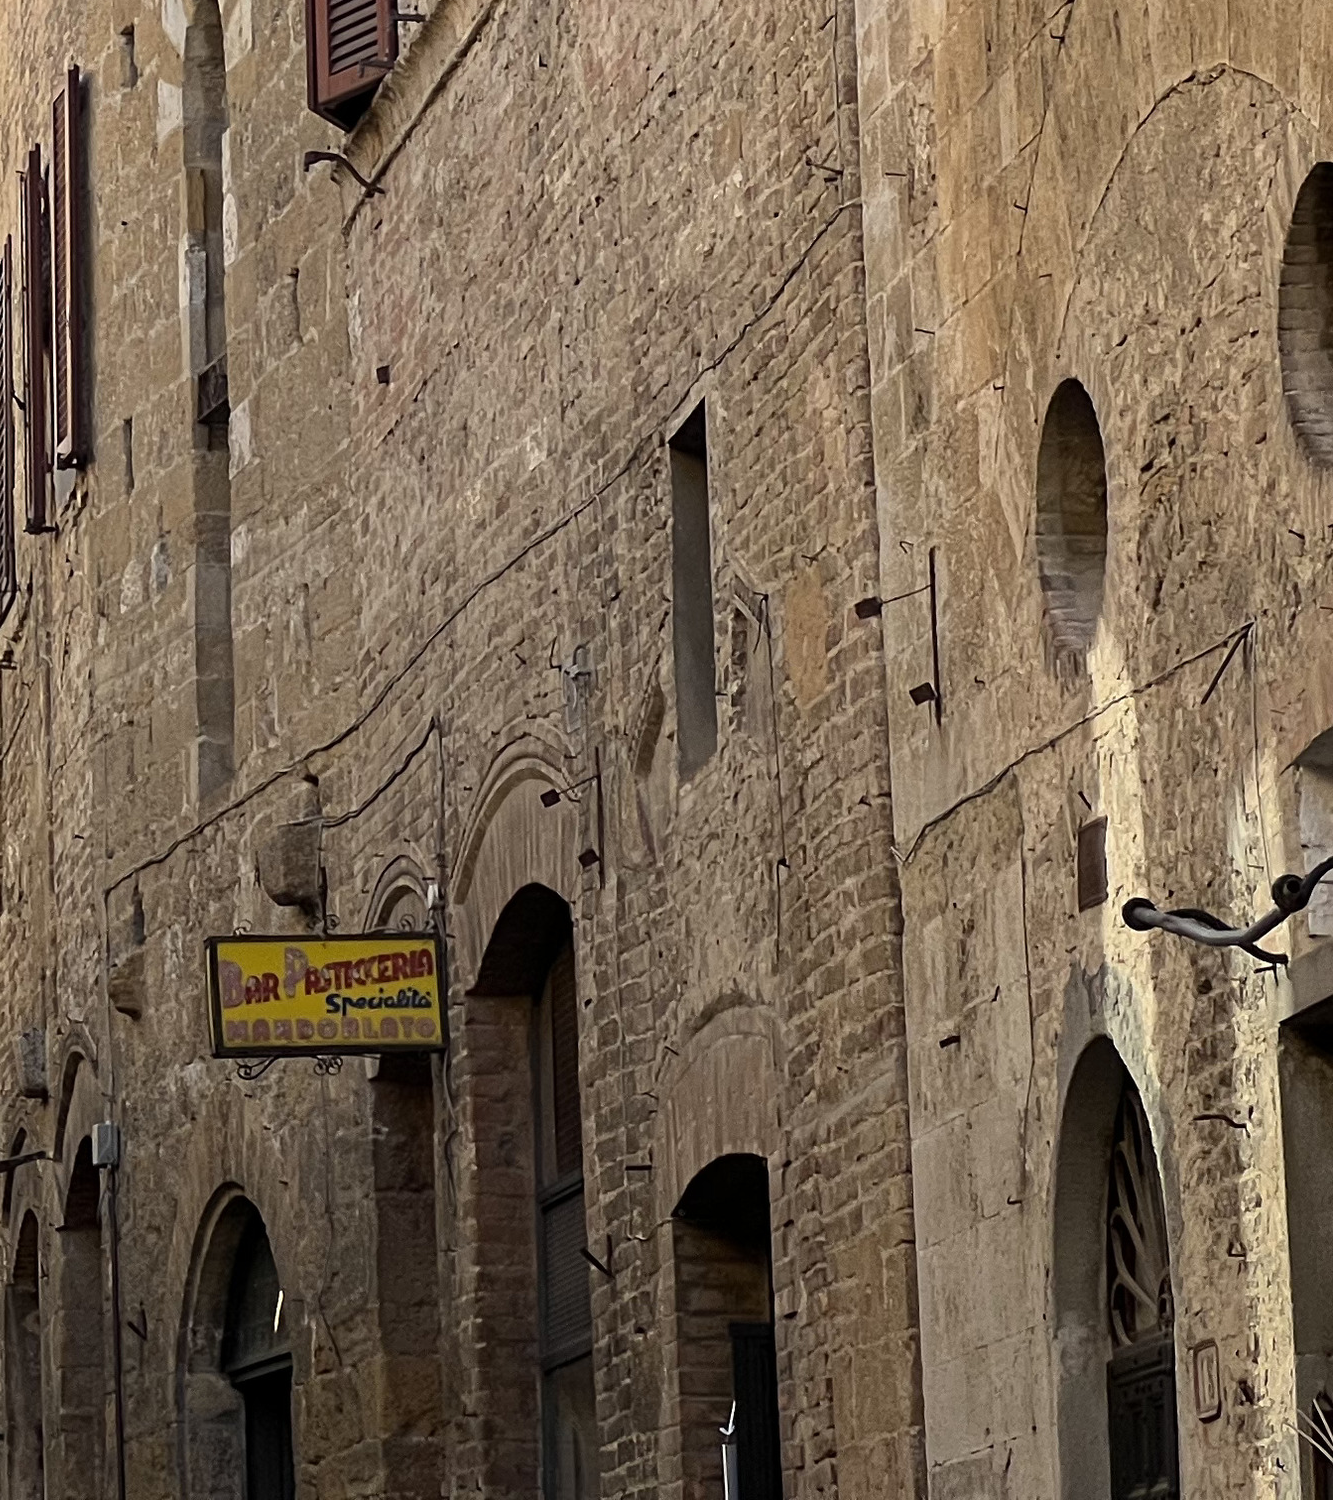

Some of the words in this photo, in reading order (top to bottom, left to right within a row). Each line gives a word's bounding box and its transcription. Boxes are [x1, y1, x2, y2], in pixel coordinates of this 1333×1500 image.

[219, 960, 281, 1008] BAR
[284, 947, 434, 998] PASTICCERIA
[326, 987, 432, 1016] Specialità
[226, 1017, 437, 1042] MANDORLATO
